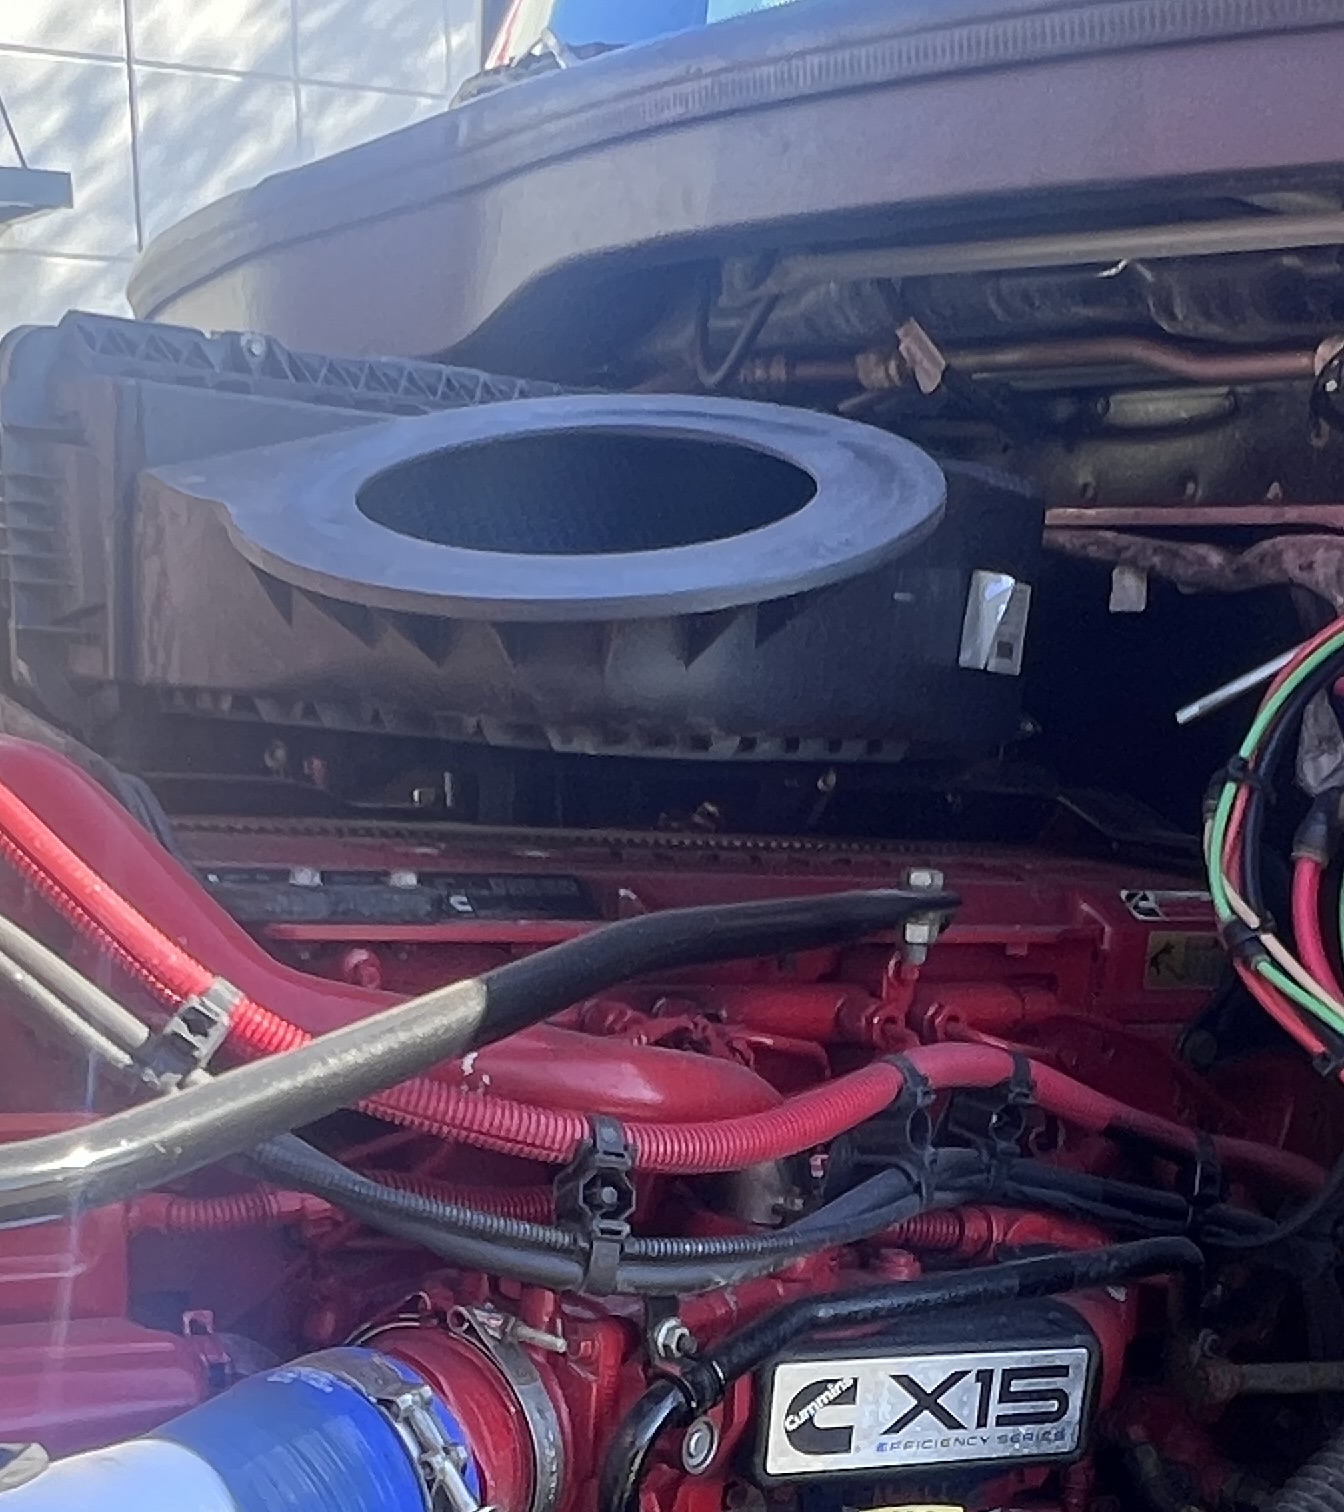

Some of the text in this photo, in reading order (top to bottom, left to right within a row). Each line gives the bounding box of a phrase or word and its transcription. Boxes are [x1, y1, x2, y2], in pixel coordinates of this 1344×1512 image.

[881, 1365, 1070, 1435] X15
[875, 1430, 1066, 1453] EFFICIENCY SERIES
